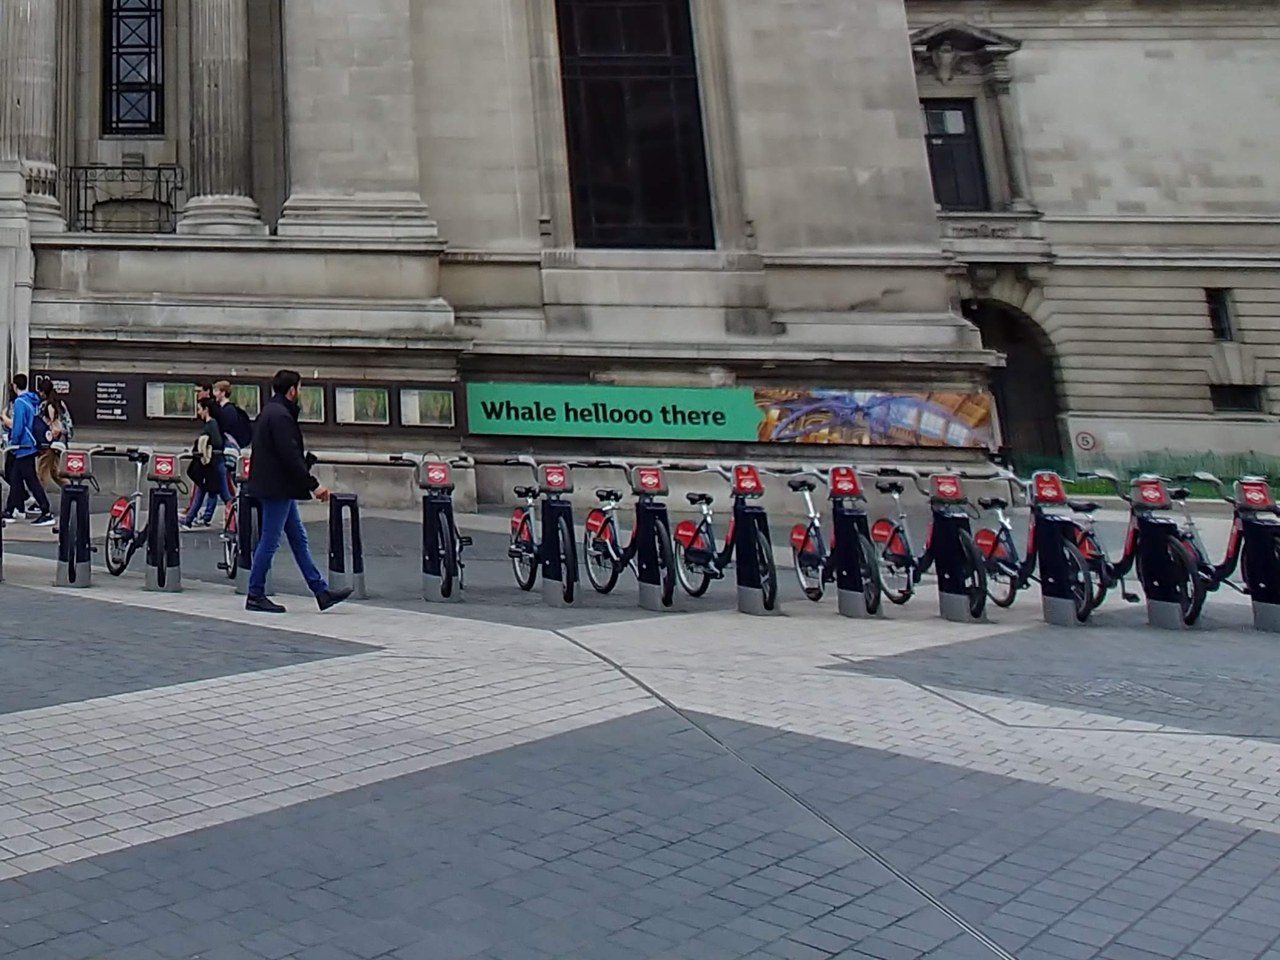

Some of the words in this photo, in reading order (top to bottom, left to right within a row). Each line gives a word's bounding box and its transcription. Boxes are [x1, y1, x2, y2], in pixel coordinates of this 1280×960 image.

[480, 400, 557, 422] Whale
[564, 402, 654, 425] hellooo
[659, 404, 726, 426] there
[1081, 436, 1090, 447] 5
